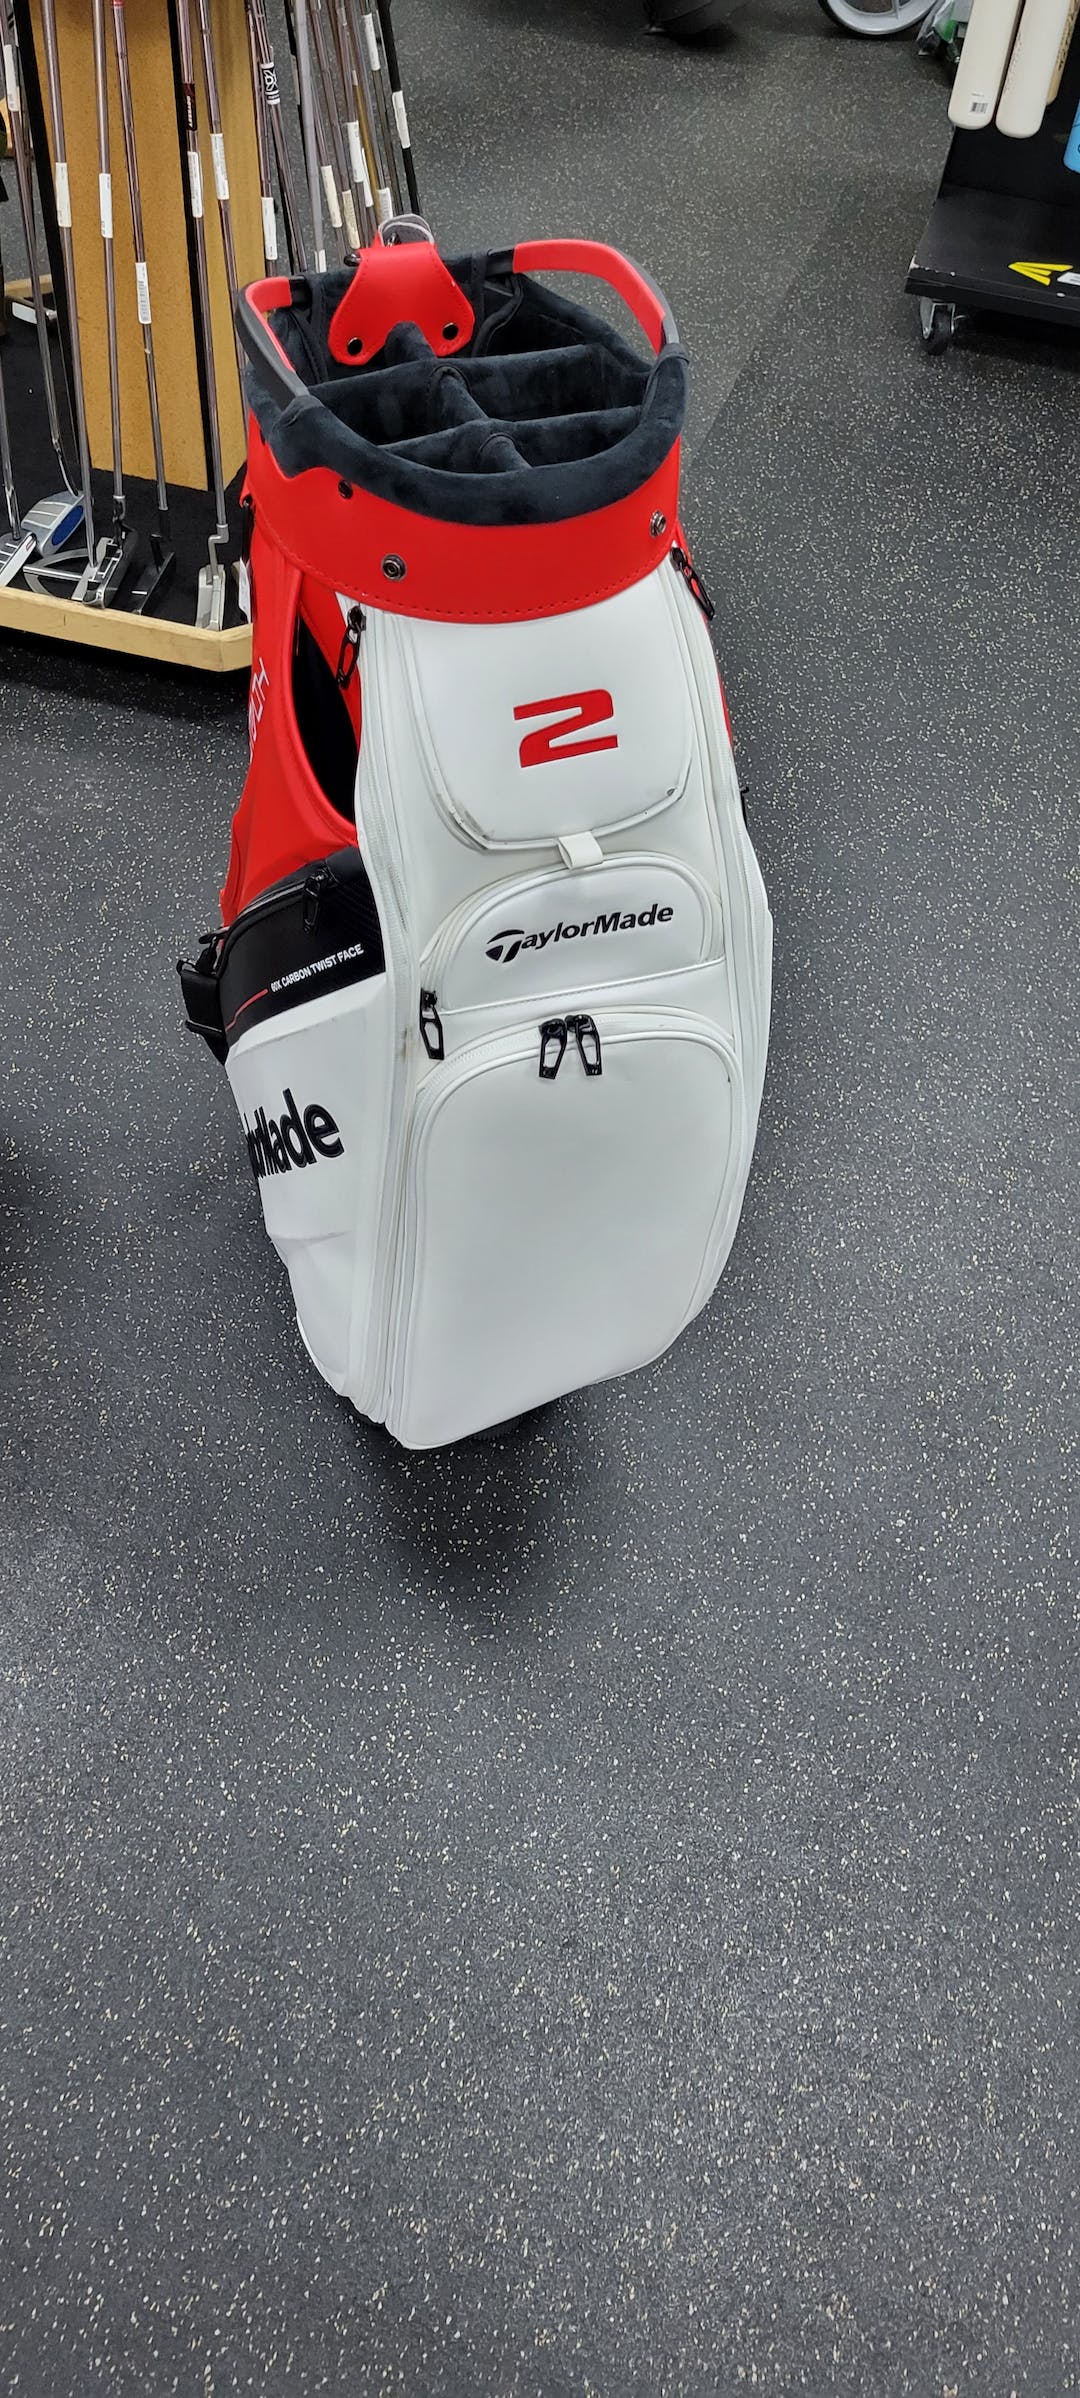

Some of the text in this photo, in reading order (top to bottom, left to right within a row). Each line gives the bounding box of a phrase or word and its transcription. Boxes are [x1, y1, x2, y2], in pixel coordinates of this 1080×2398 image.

[513, 688, 619, 768] 2
[485, 903, 674, 963] TaylorMade
[281, 966, 311, 987] CARBON
[310, 955, 337, 973] TWIST
[337, 943, 364, 962] FACE
